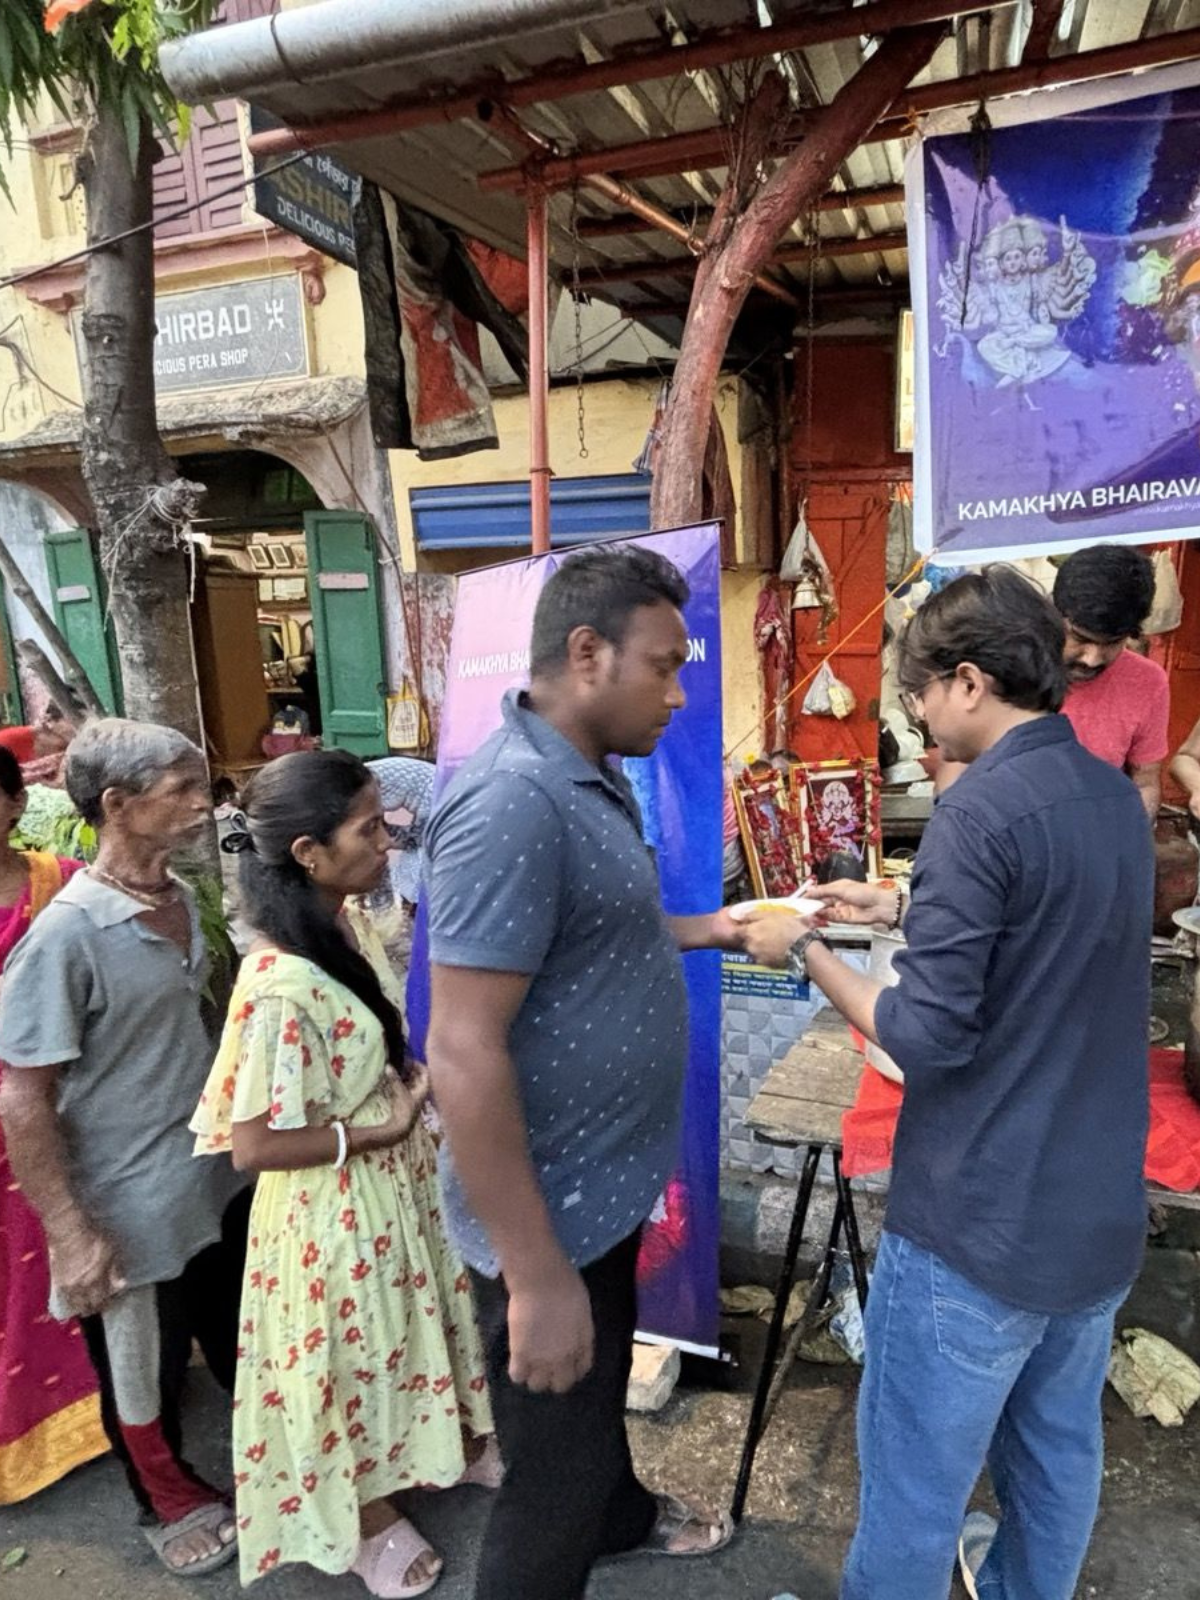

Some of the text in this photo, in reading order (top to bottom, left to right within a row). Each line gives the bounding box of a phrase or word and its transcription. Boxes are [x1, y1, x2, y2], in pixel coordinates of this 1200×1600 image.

[277, 196, 337, 244] DELICIOUS
[189, 352, 217, 371] PERA
[220, 347, 248, 367] SHOP
[958, 490, 1087, 521] KAMAKHYA
[458, 653, 509, 679] KAMAKHYA
